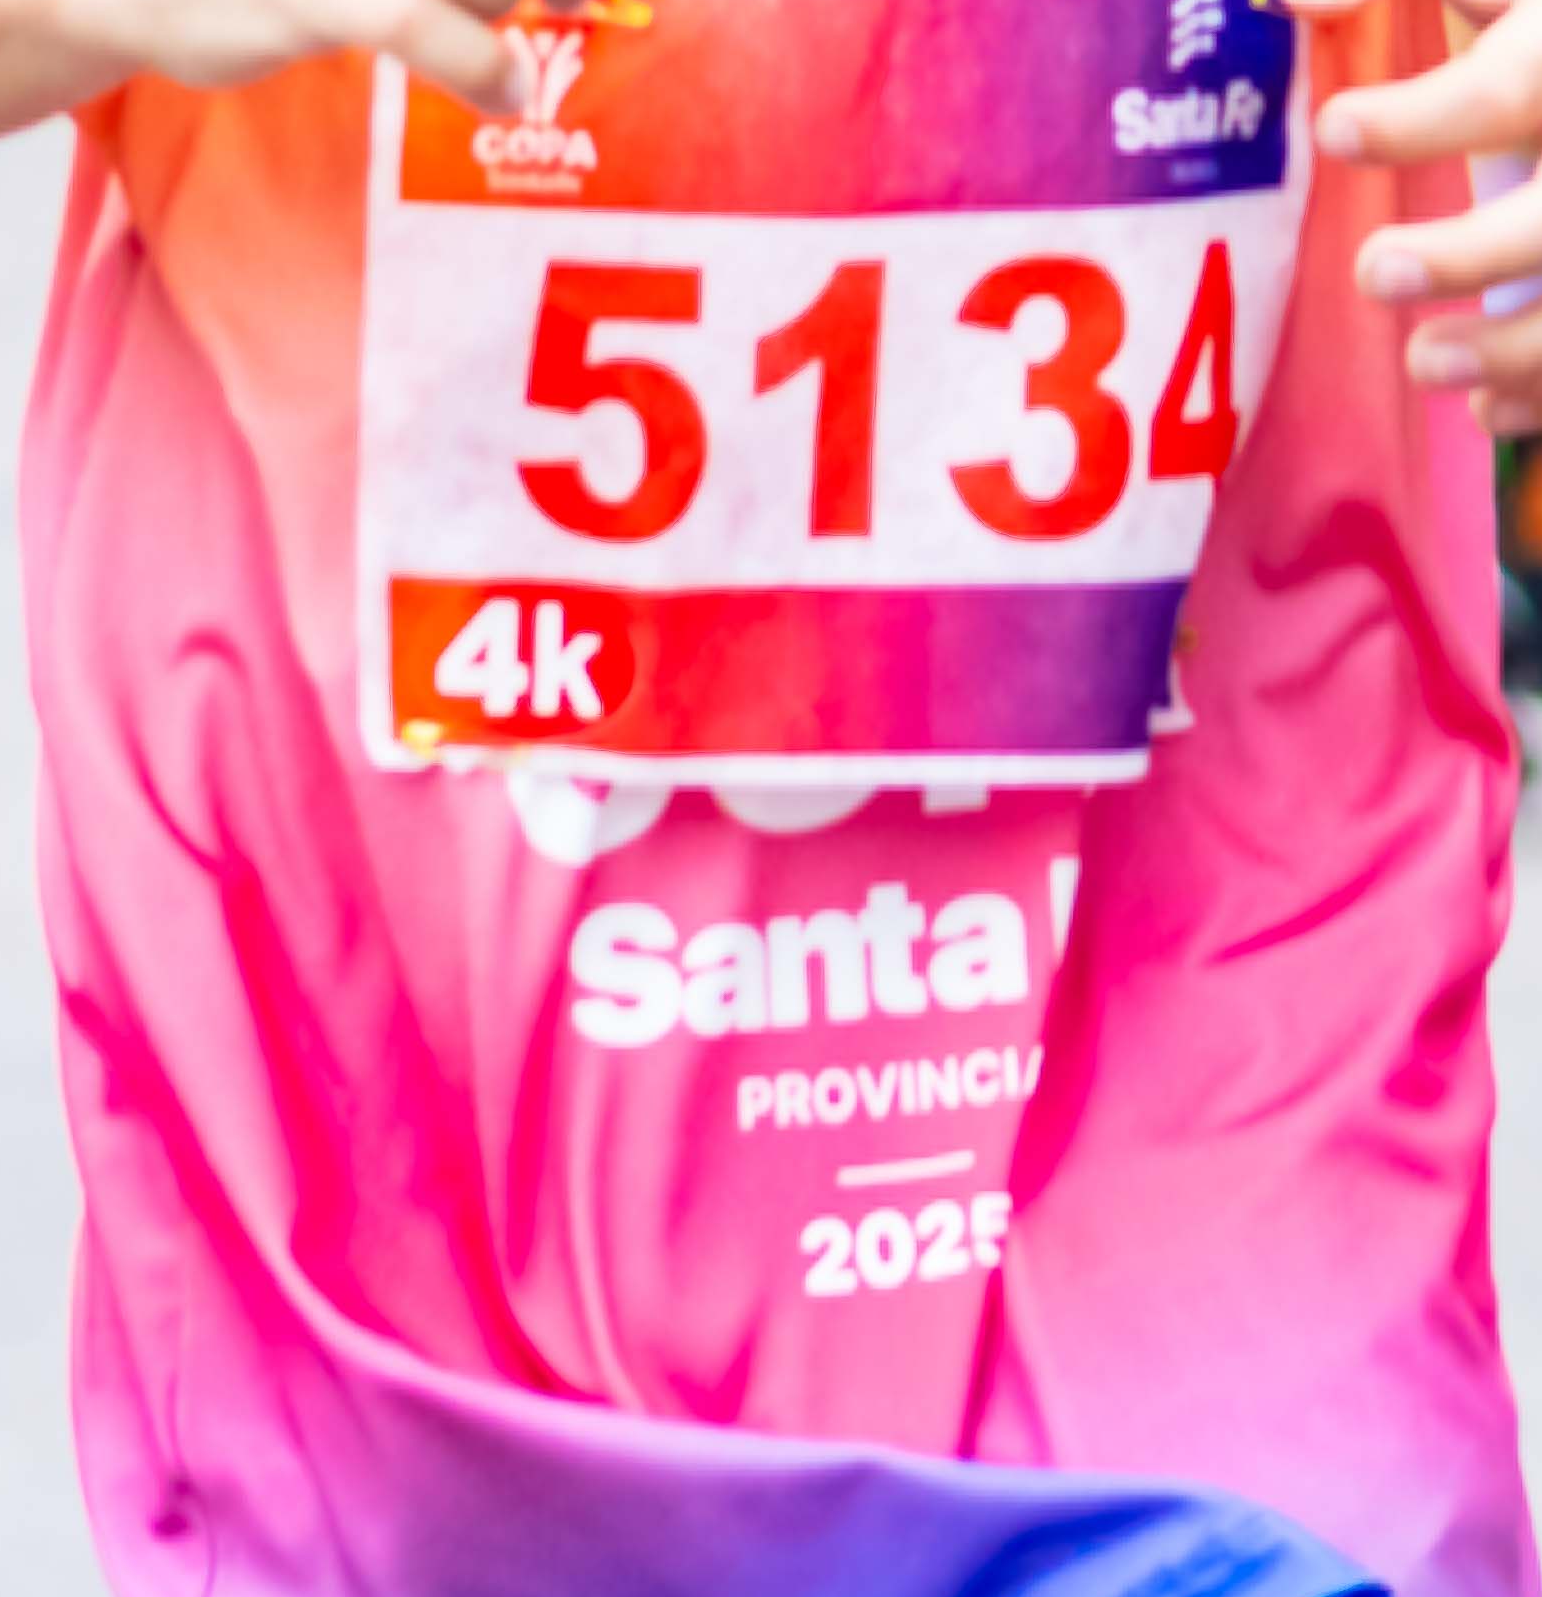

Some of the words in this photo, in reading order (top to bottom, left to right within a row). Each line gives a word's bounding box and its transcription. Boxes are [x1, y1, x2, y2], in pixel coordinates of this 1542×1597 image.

[471, 124, 598, 172] COPA
[517, 238, 1239, 544] 5134
[434, 597, 605, 721] 4k
[570, 881, 1029, 1048] Santa
